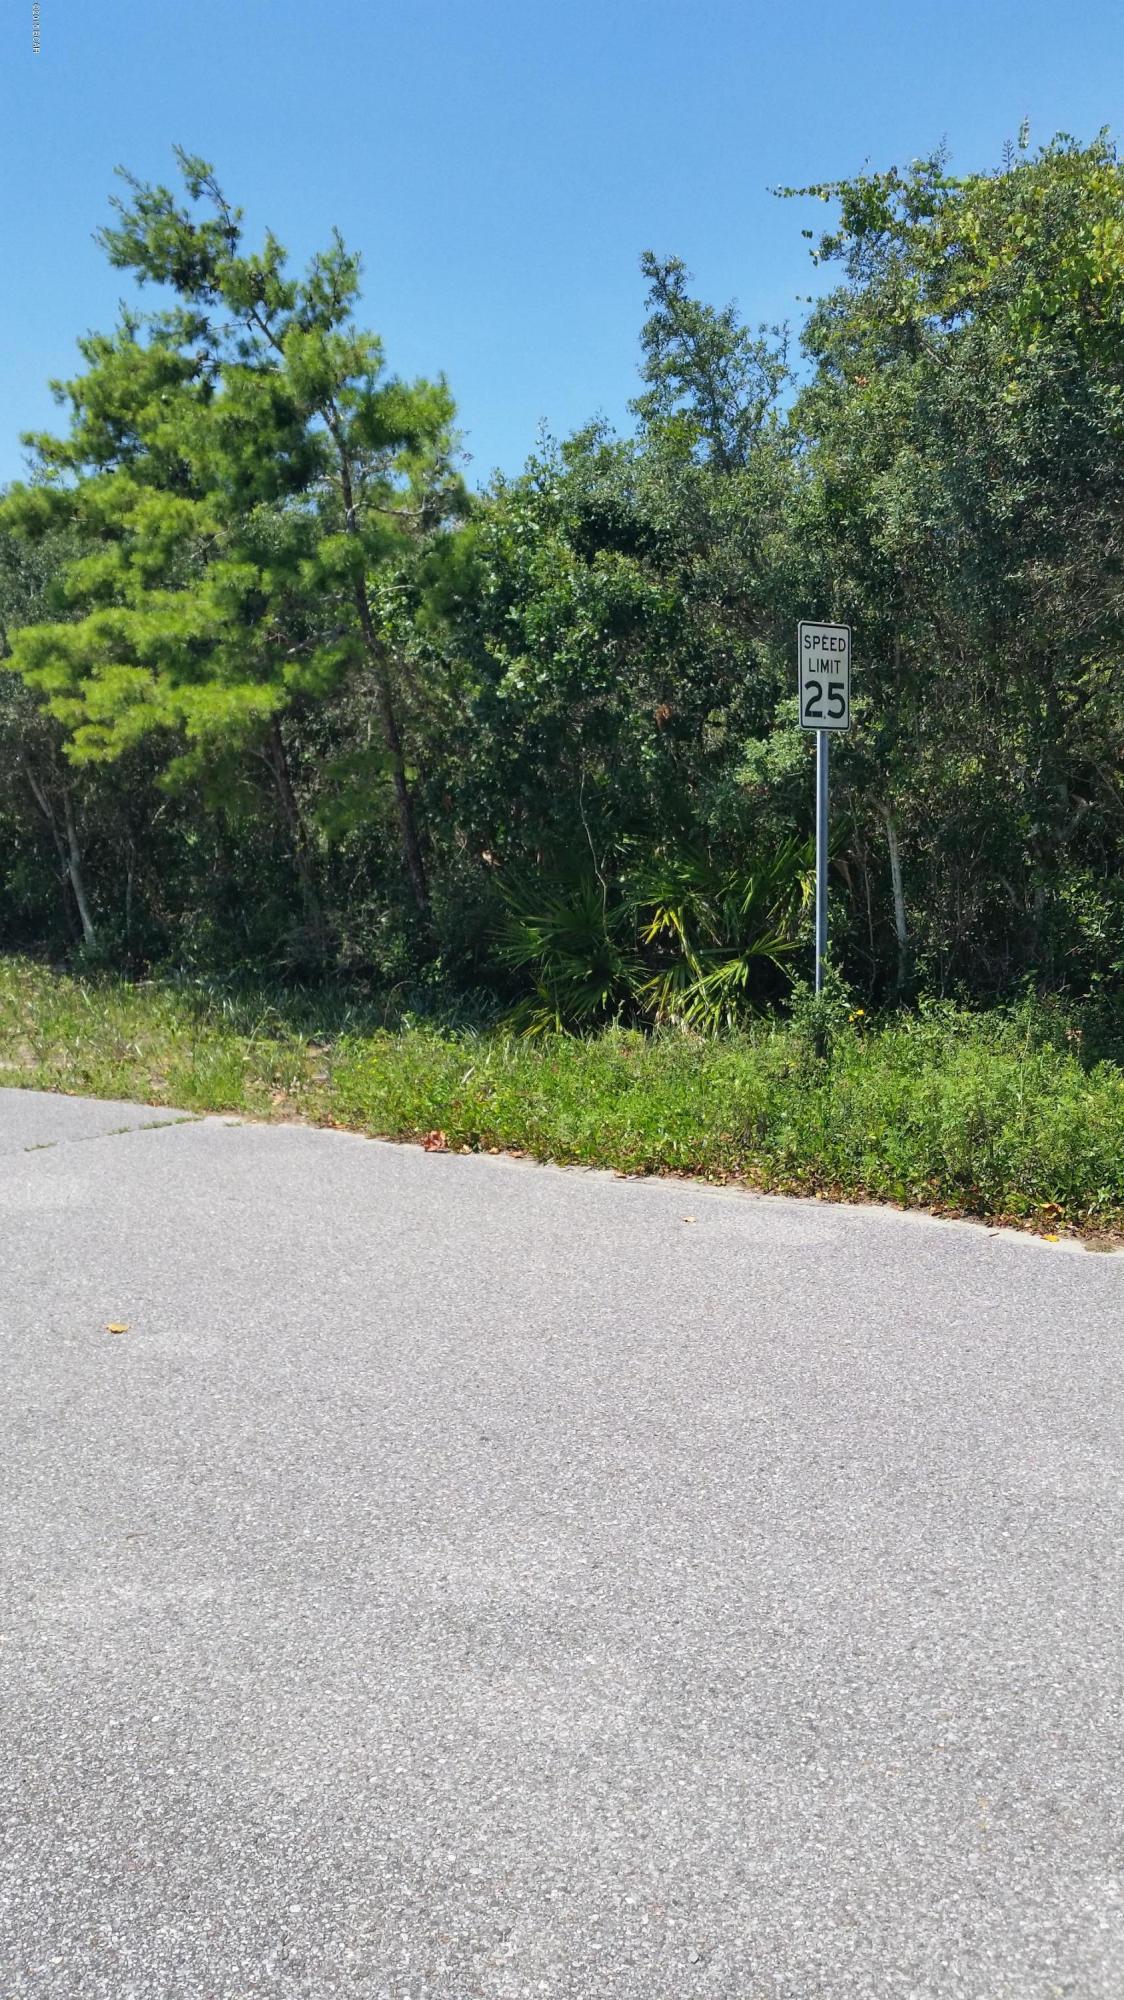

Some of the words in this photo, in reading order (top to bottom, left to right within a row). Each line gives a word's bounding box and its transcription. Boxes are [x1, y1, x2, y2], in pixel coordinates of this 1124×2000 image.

[804, 634, 846, 653] SPEED
[808, 657, 841, 675] LIMIT
[804, 680, 846, 719] 25
